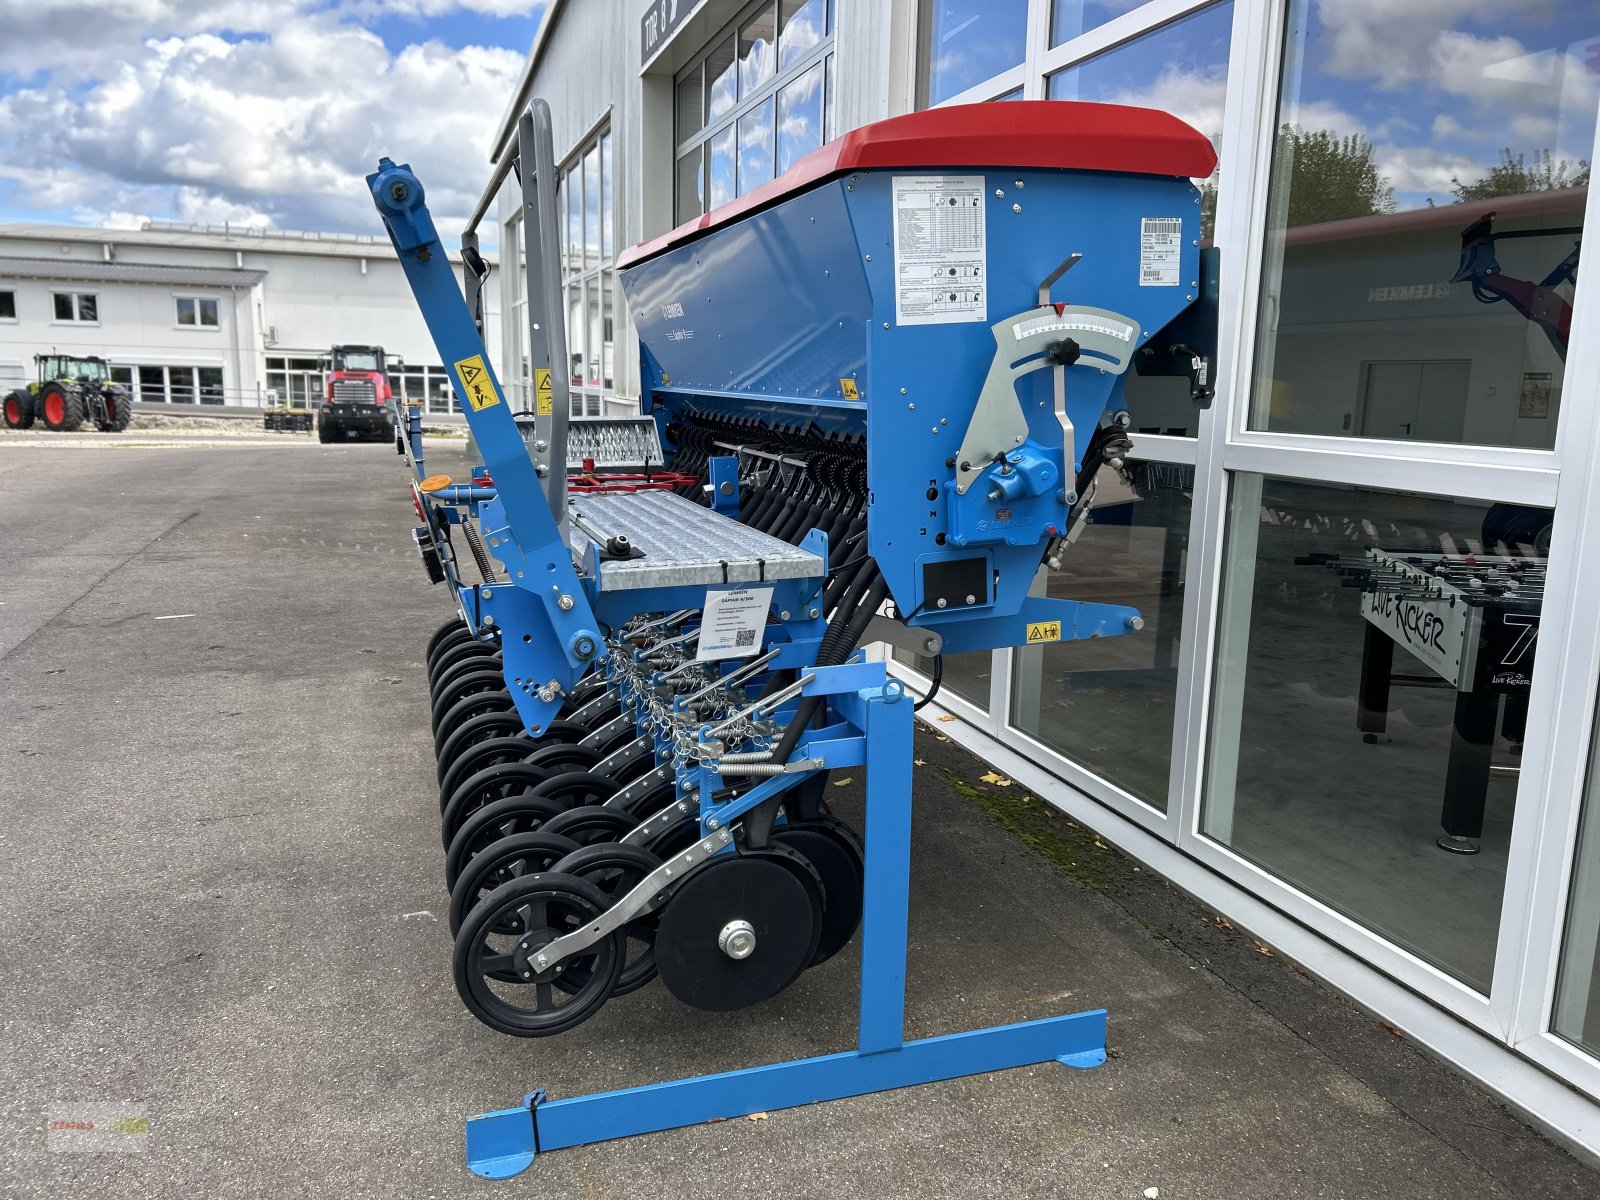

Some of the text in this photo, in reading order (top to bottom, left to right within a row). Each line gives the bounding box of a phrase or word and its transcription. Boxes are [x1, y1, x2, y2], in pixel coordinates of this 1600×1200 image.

[645, 0, 666, 51] TOR 8
[1395, 594, 1446, 655] KICKER
[1501, 613, 1541, 665] 7
